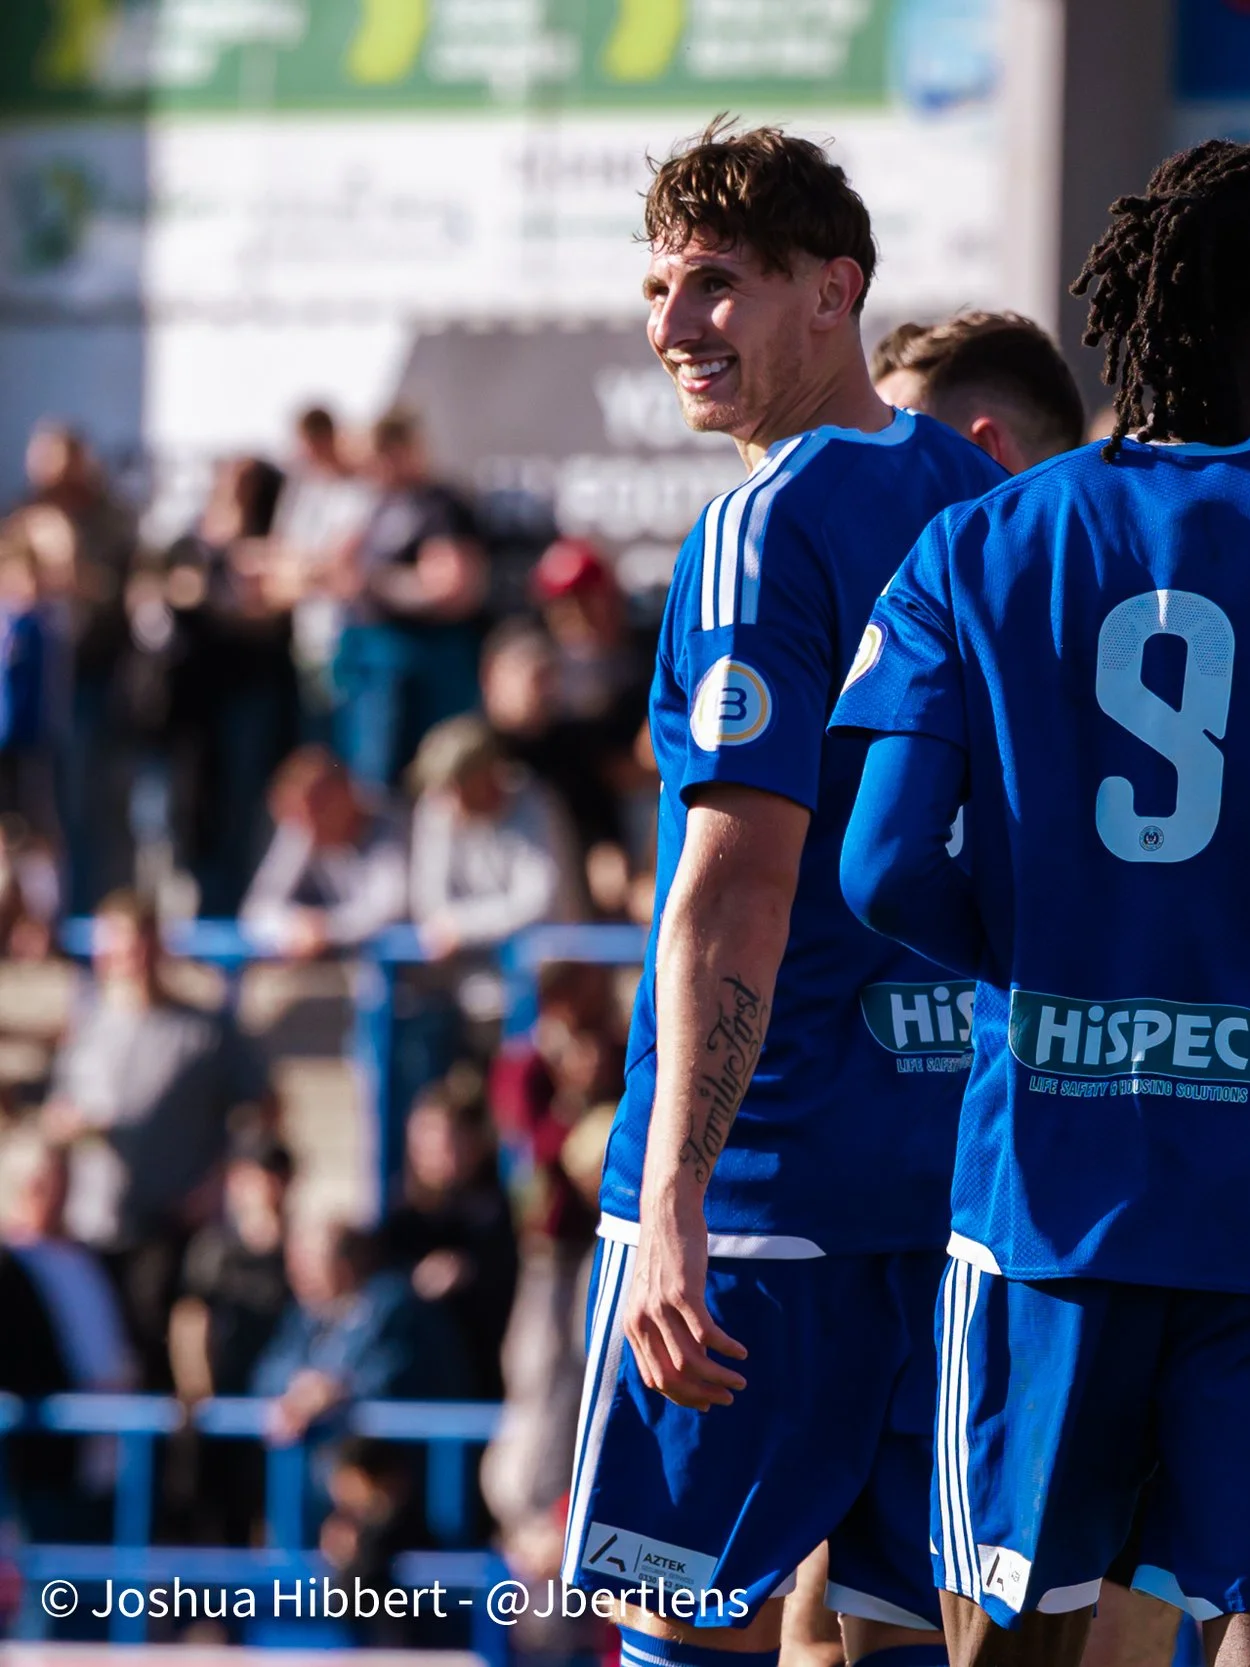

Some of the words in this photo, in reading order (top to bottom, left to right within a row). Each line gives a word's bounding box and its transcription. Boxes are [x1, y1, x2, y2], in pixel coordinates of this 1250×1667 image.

[1095, 588, 1236, 863] 9
[1034, 1004, 1250, 1071] HiSPEC
[896, 1057, 924, 1073] LIFE
[1028, 1075, 1059, 1094] LIFE
[1060, 1079, 1109, 1097] SAFETY
[1118, 1078, 1173, 1096] HOUSING
[1176, 1082, 1248, 1103] SOLUTIONS
[643, 1552, 687, 1574] AZTEK
